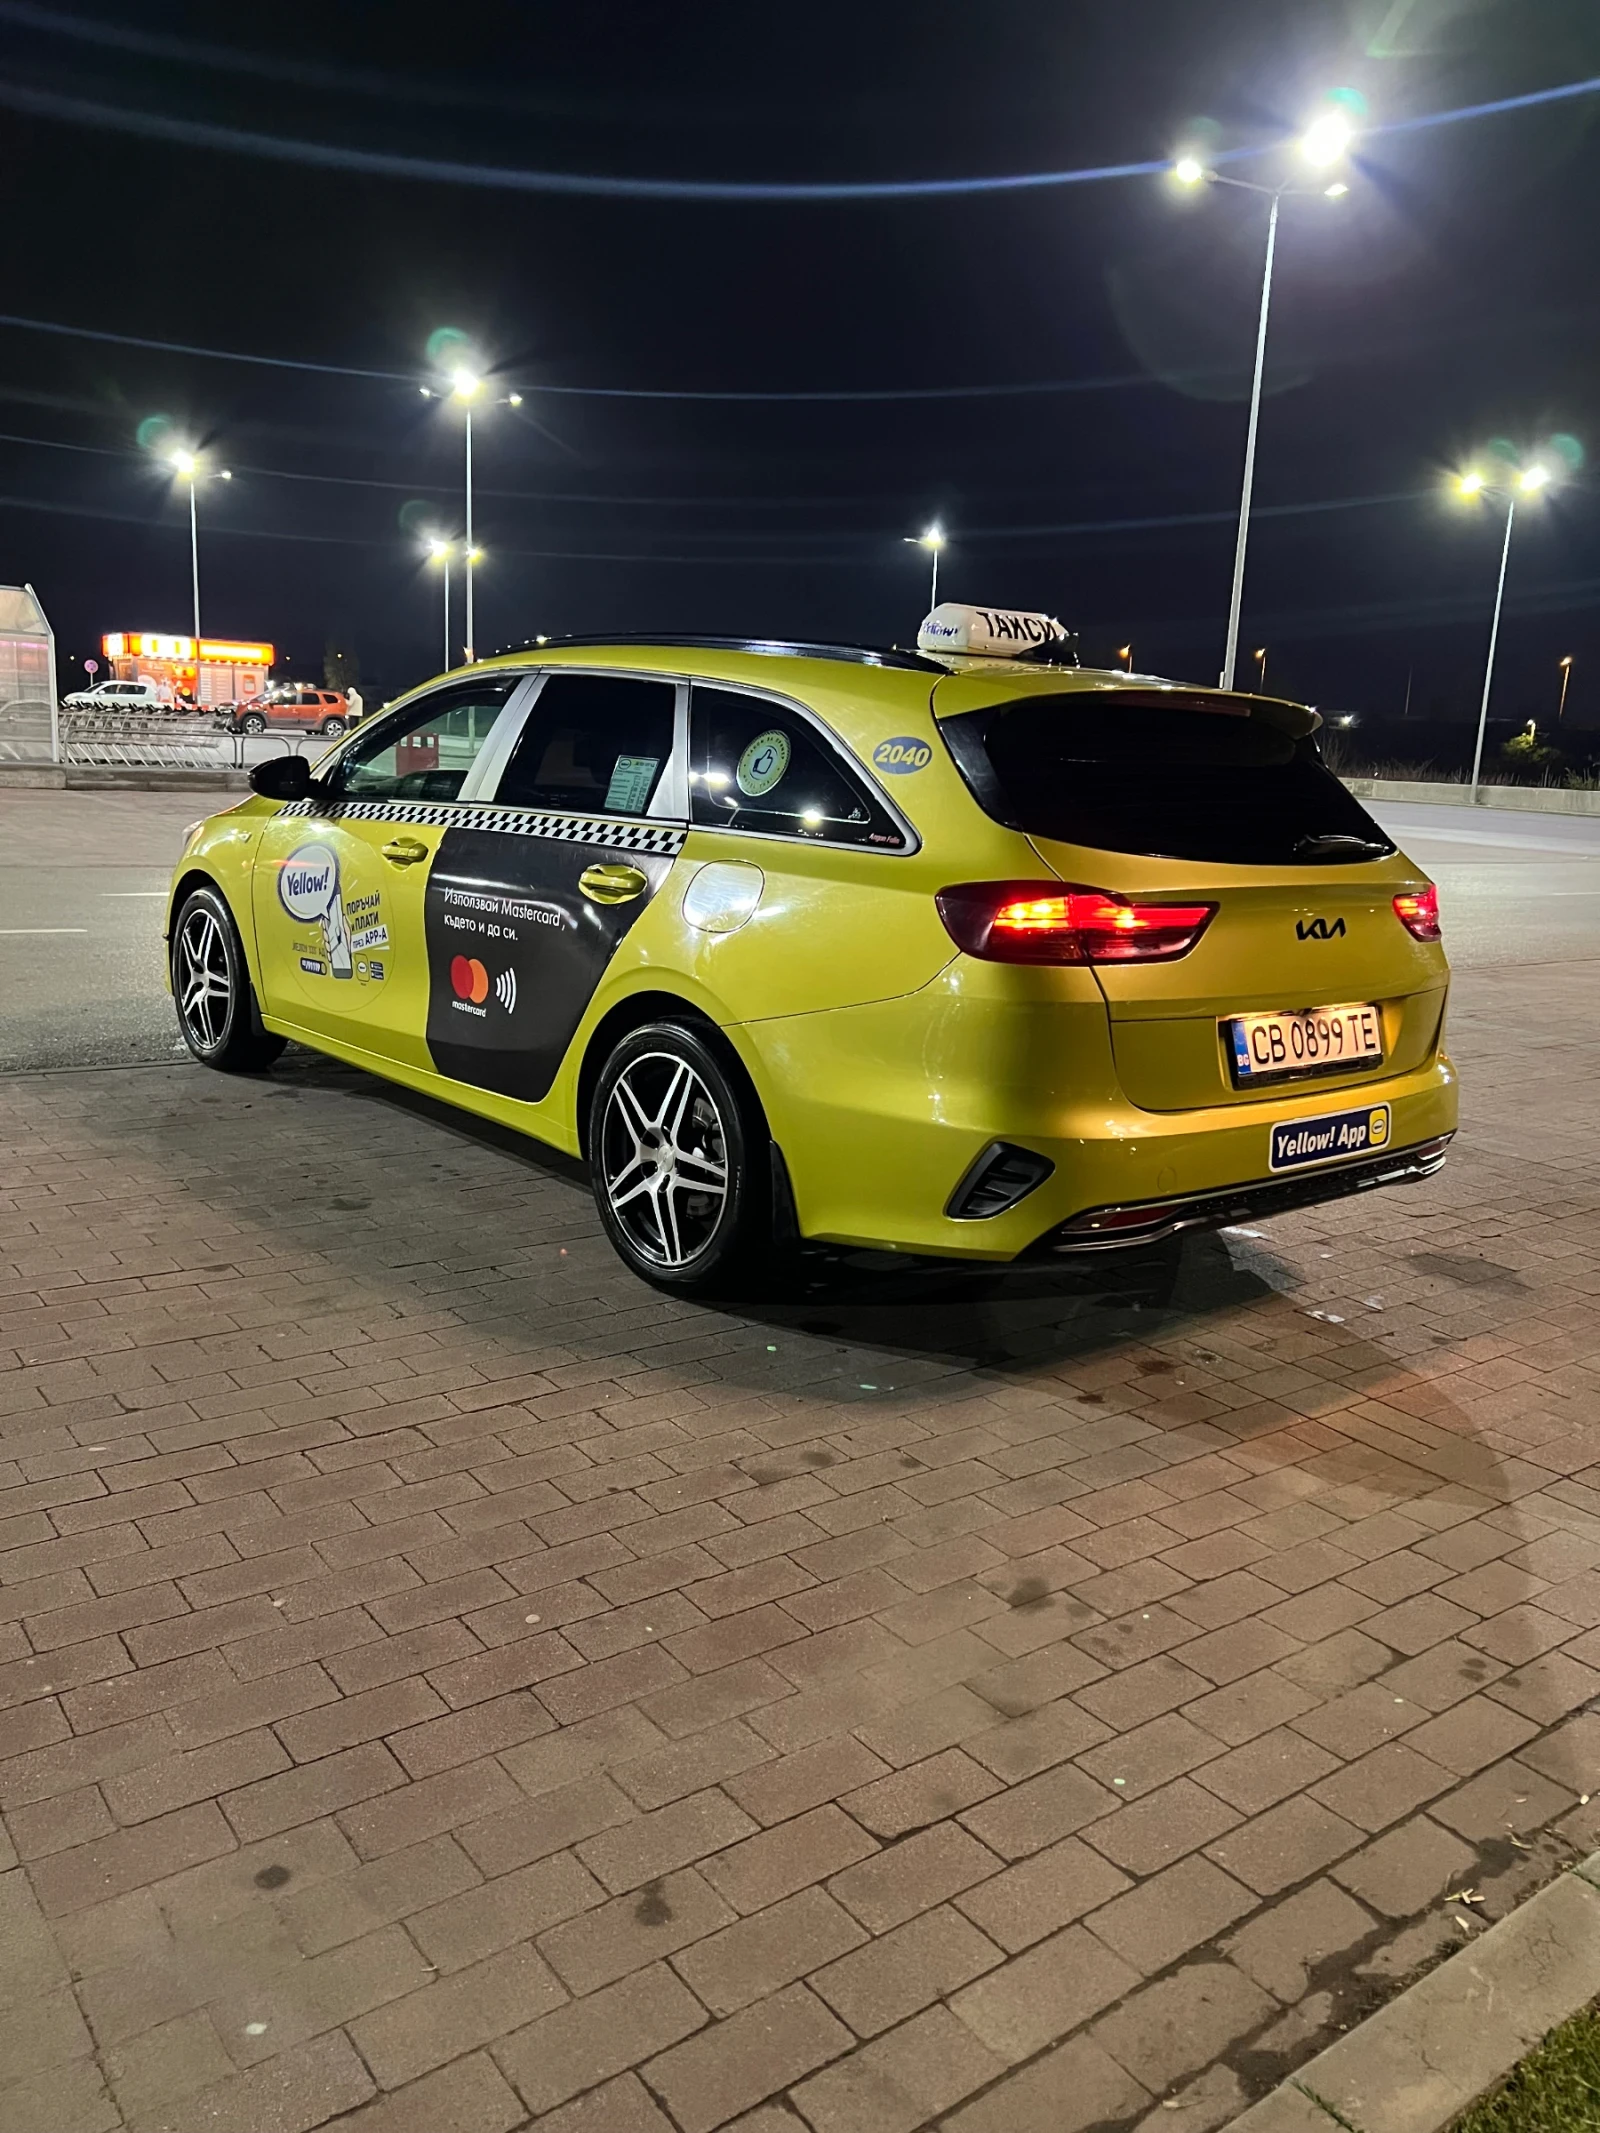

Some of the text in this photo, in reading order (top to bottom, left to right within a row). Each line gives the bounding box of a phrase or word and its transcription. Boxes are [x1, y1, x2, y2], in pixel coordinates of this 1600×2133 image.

[876, 744, 929, 766] 2040
[287, 867, 330, 897] Yellow!
[346, 889, 381, 916] ПОРЪЧАЙ
[444, 887, 498, 914] Използвай
[355, 911, 380, 931] ПЛАТИ
[444, 914, 519, 941] където и да си.
[452, 1001, 486, 1018] mastercard
[1251, 1012, 1377, 1066] CB 0899 TE
[1236, 1054, 1250, 1068] BG
[1277, 1121, 1367, 1159] Yellow! App
